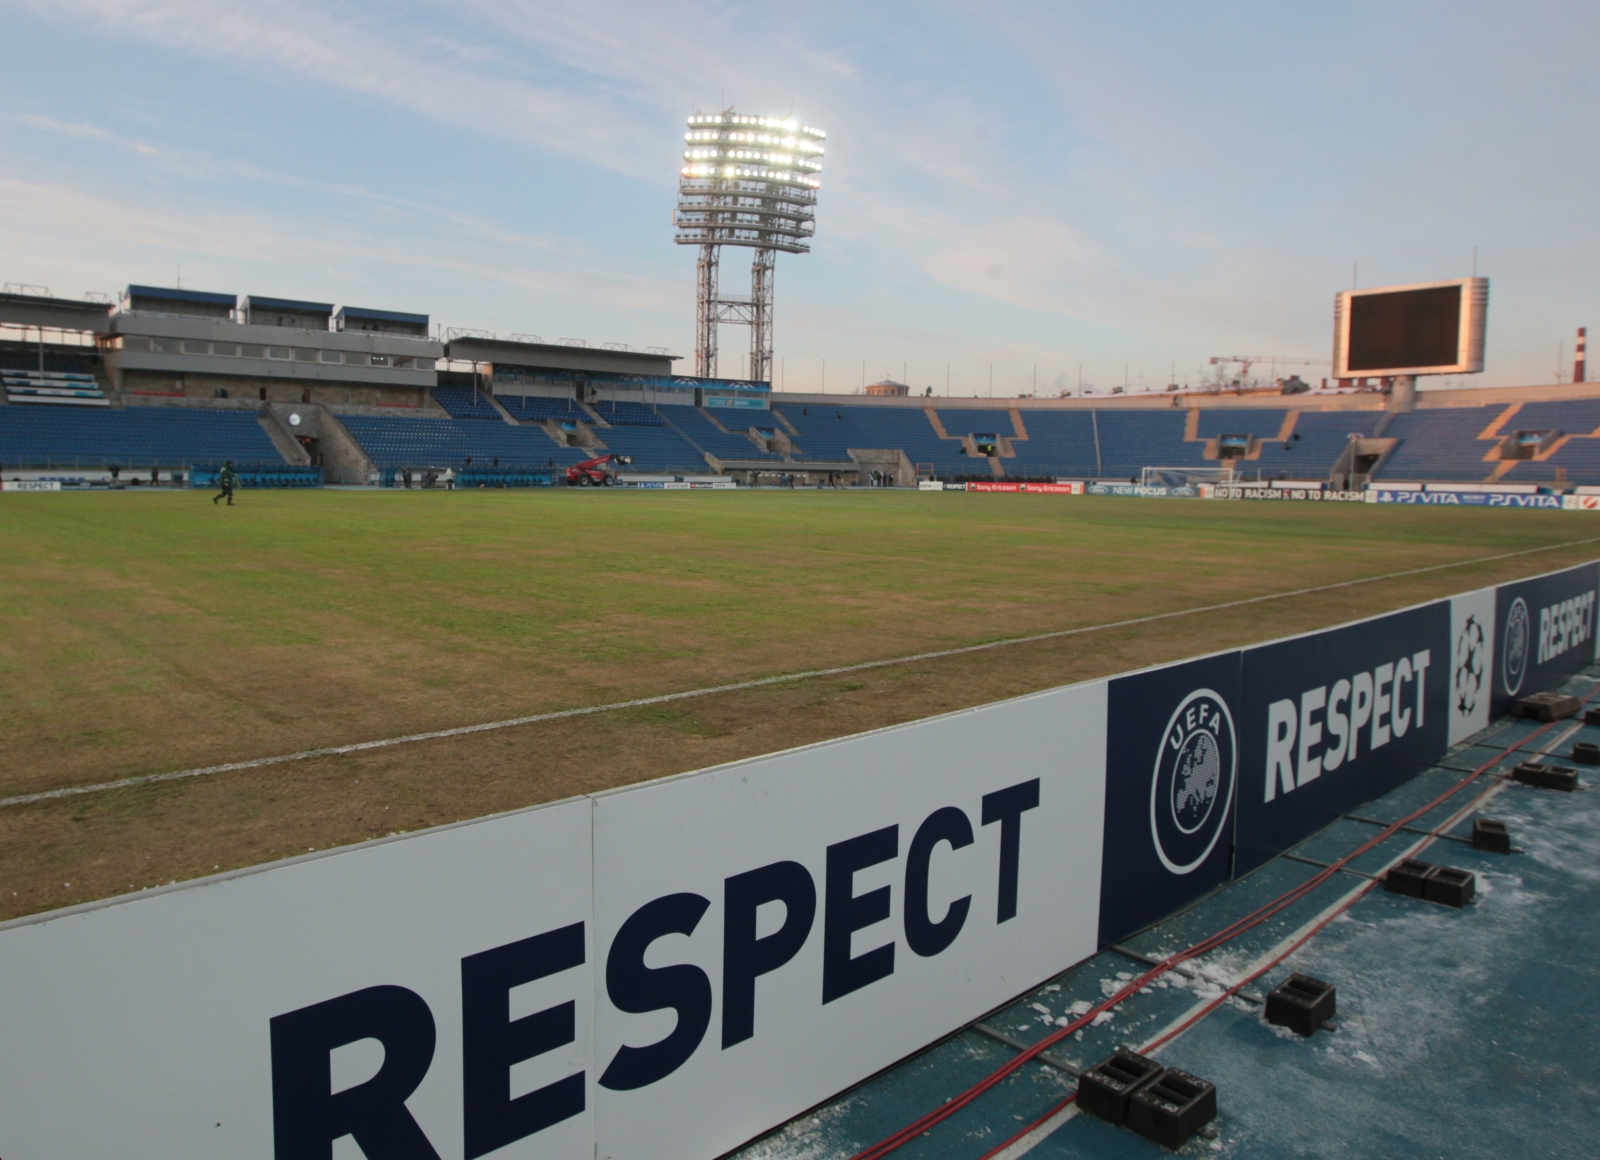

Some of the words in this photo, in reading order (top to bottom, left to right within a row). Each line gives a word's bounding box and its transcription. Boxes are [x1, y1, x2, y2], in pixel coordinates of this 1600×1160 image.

[976, 484, 991, 492] Sony
[1027, 485, 1042, 493] Sony
[1112, 486, 1134, 495] NEW
[1134, 486, 1167, 496] FOCUS
[1215, 488, 1228, 498] NO
[1230, 488, 1243, 498] TO
[1244, 488, 1282, 499] RACISM
[1291, 489, 1306, 500] NO
[1308, 490, 1321, 500] TO
[1323, 490, 1364, 501] RACISM
[1537, 590, 1595, 665] RESPECT
[1170, 703, 1221, 750] UEFA
[1264, 648, 1430, 804] RESPECT
[269, 777, 1041, 1160] RESPECT
